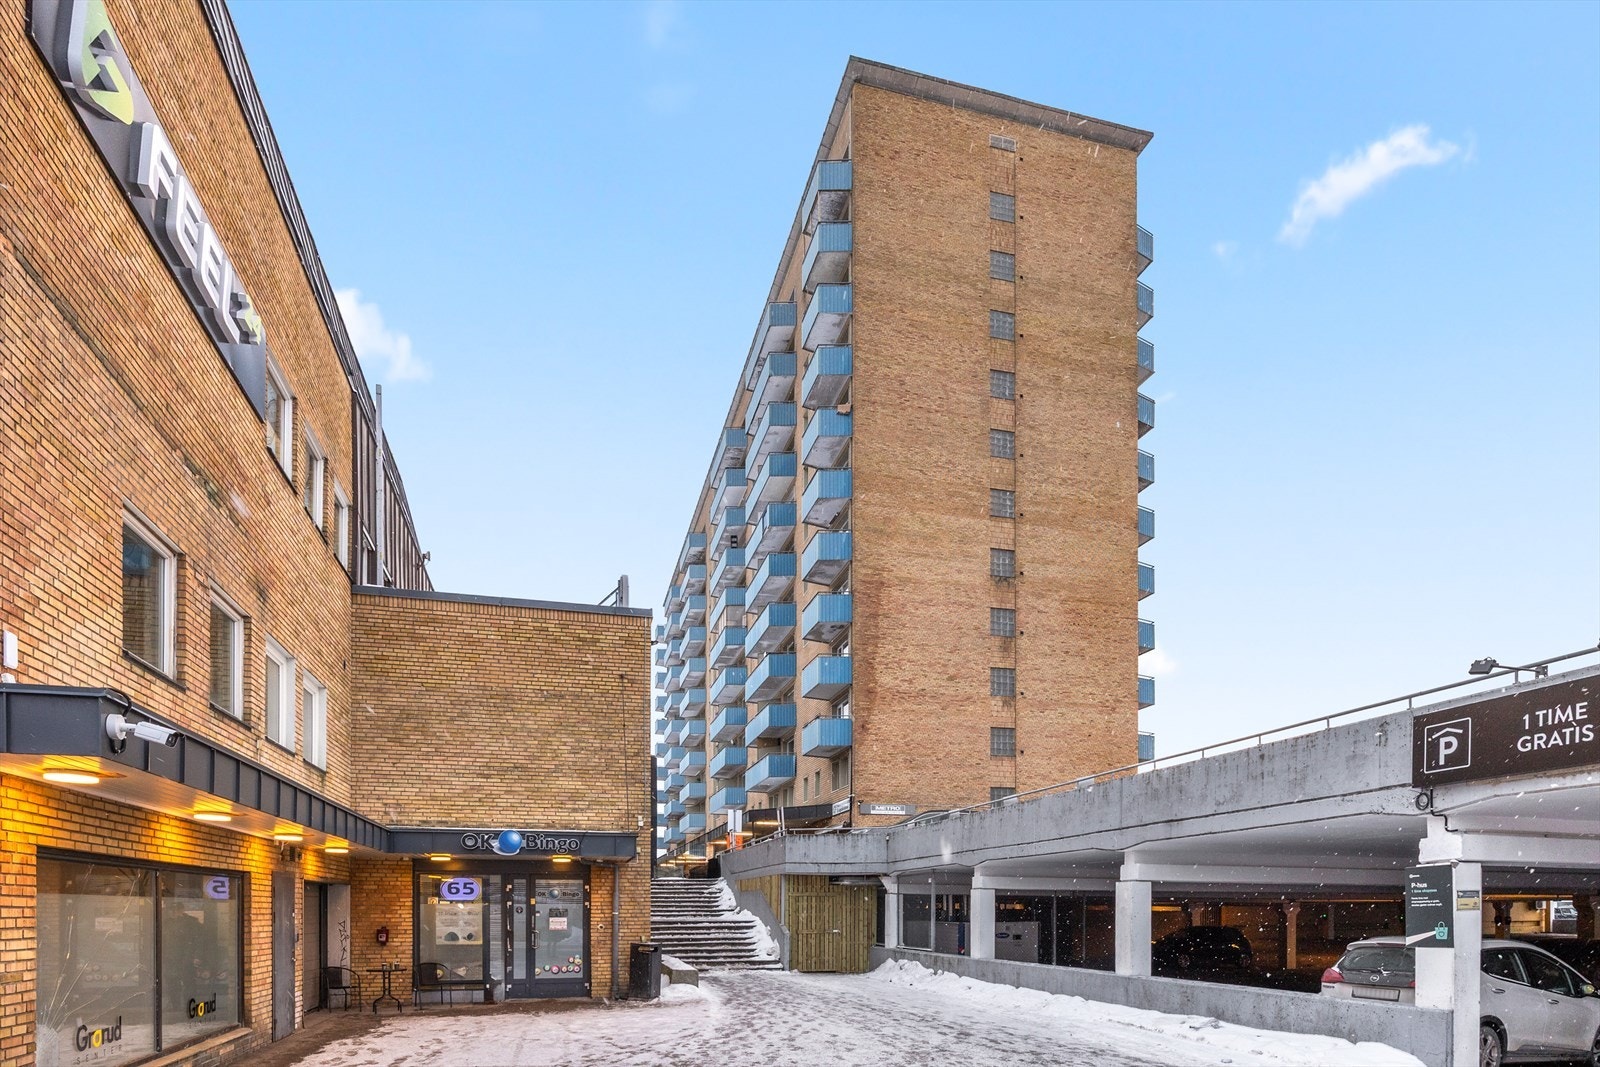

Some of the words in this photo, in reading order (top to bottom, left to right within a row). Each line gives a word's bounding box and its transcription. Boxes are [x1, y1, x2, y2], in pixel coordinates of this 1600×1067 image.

[1523, 713, 1530, 730] 1
[1535, 702, 1588, 727] TIME
[1517, 724, 1595, 752] GRATIS
[461, 832, 495, 850] OK
[525, 833, 580, 854] Bingo
[447, 881, 475, 896] 65
[562, 889, 580, 898] Bingo
[189, 992, 217, 1019] Grorud
[76, 1015, 122, 1052] Grorud
